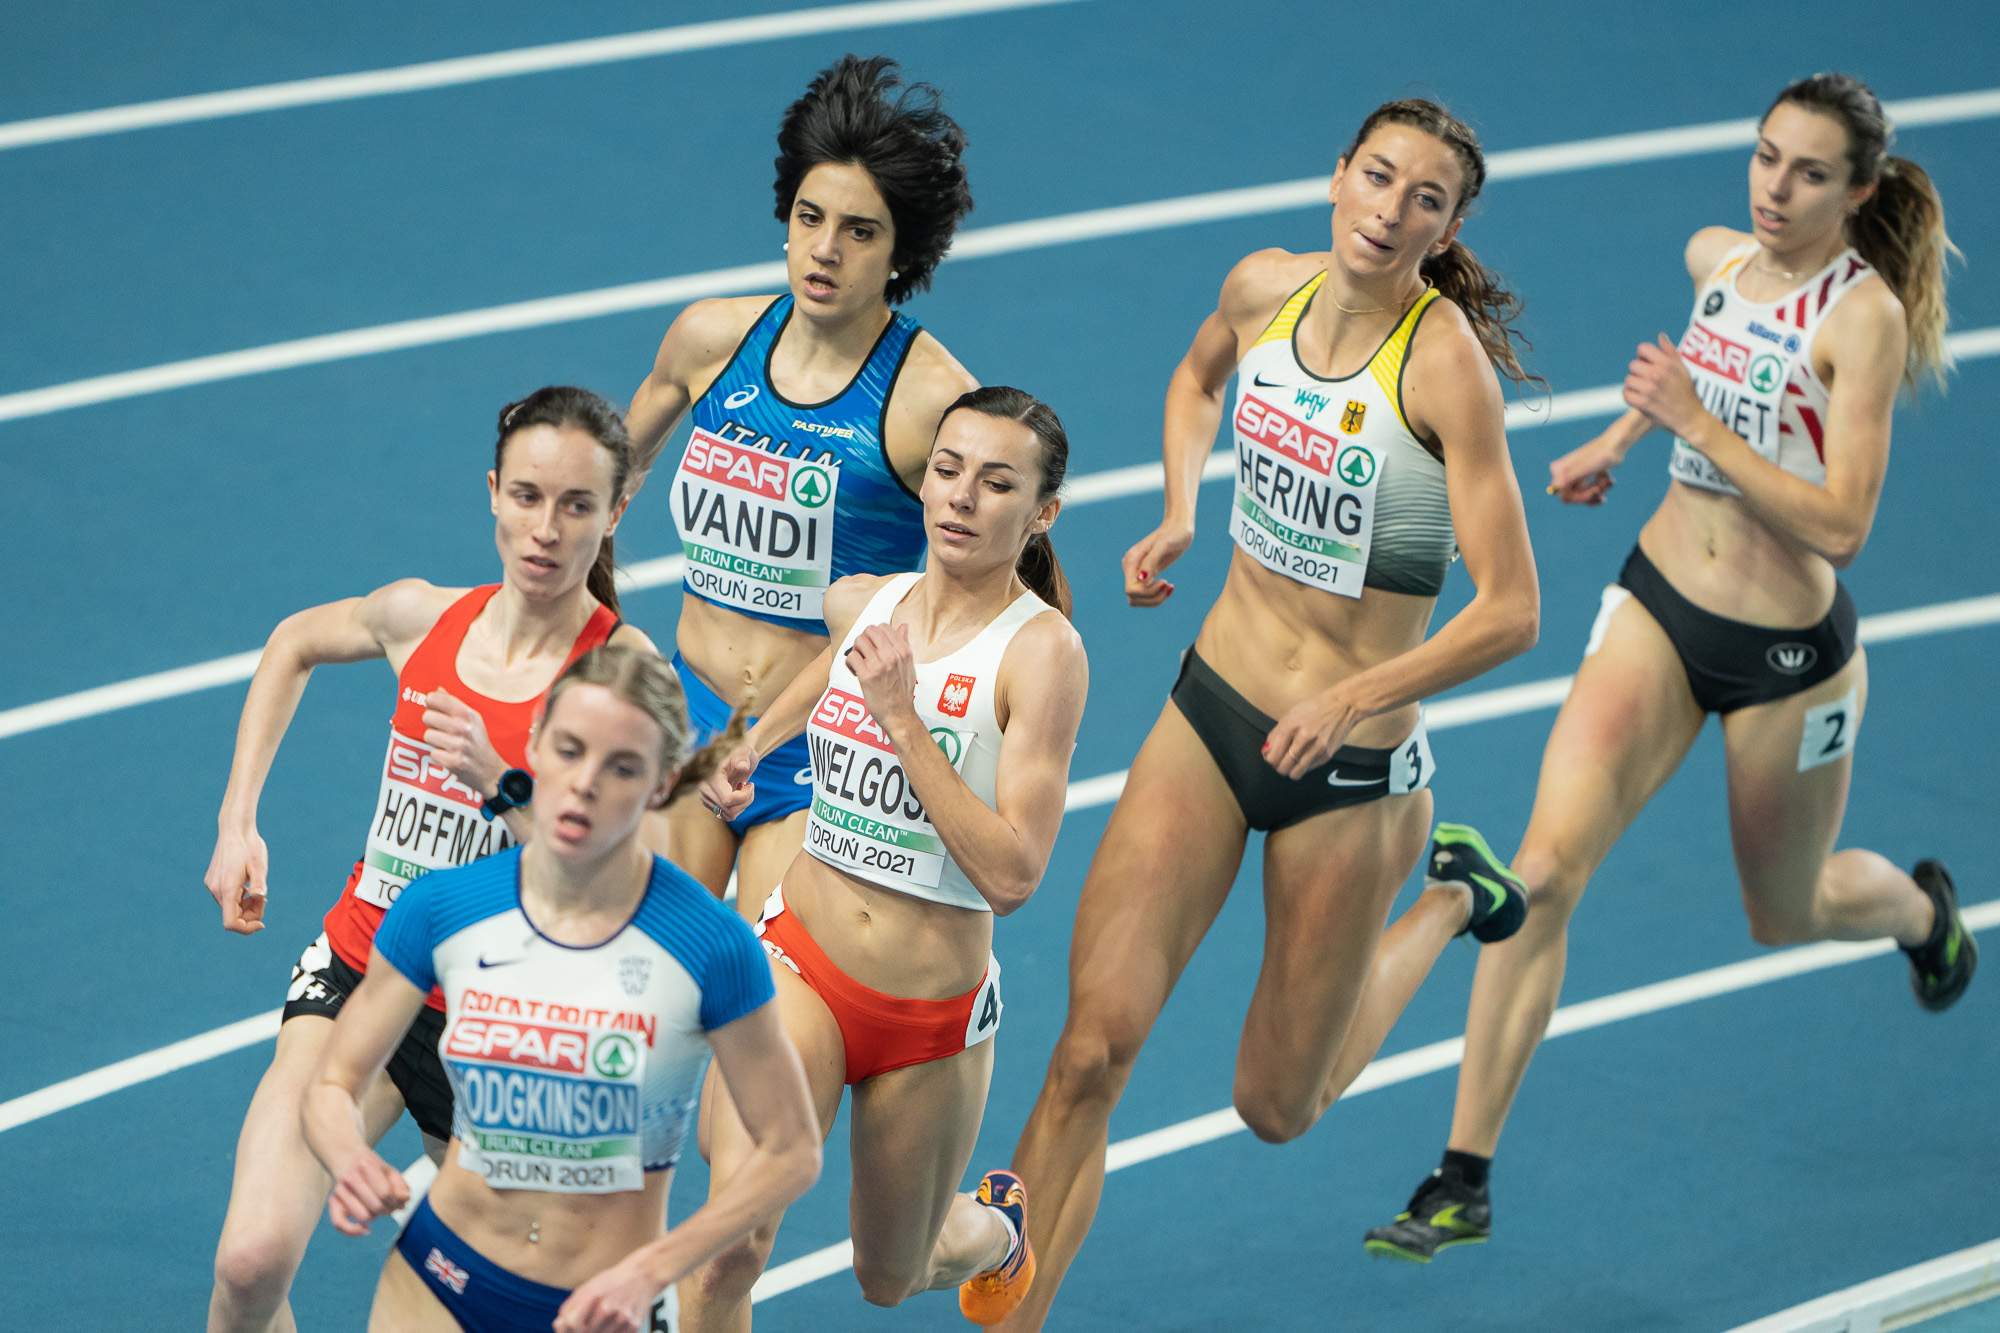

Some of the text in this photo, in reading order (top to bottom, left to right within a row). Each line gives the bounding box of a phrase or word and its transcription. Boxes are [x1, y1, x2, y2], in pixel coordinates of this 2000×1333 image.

[792, 420, 854, 439] FASTWEB
[1237, 401, 1334, 470] SPAR
[685, 438, 785, 495] SPAR
[1239, 441, 1362, 536] HERING
[682, 481, 817, 560] VANDI
[692, 546, 698, 559] I
[700, 549, 730, 569] RUN
[1241, 520, 1338, 584] TORUŃ 2021
[689, 567, 801, 611] ORUŃ 2021
[950, 674, 974, 685] POLSKA
[817, 693, 892, 746] SPA
[1820, 710, 1846, 757] 2
[391, 745, 483, 803] SPA
[809, 732, 932, 825] WIELGOS
[1406, 741, 1422, 790] 3
[821, 804, 846, 826] RUN
[392, 859, 398, 873] I
[809, 821, 915, 876] TORUŃ 2021
[977, 981, 997, 1033] 4
[449, 1021, 584, 1070] SPAR
[460, 1066, 636, 1136] ODGKINSON
[558, 1167, 615, 1186] 2021
